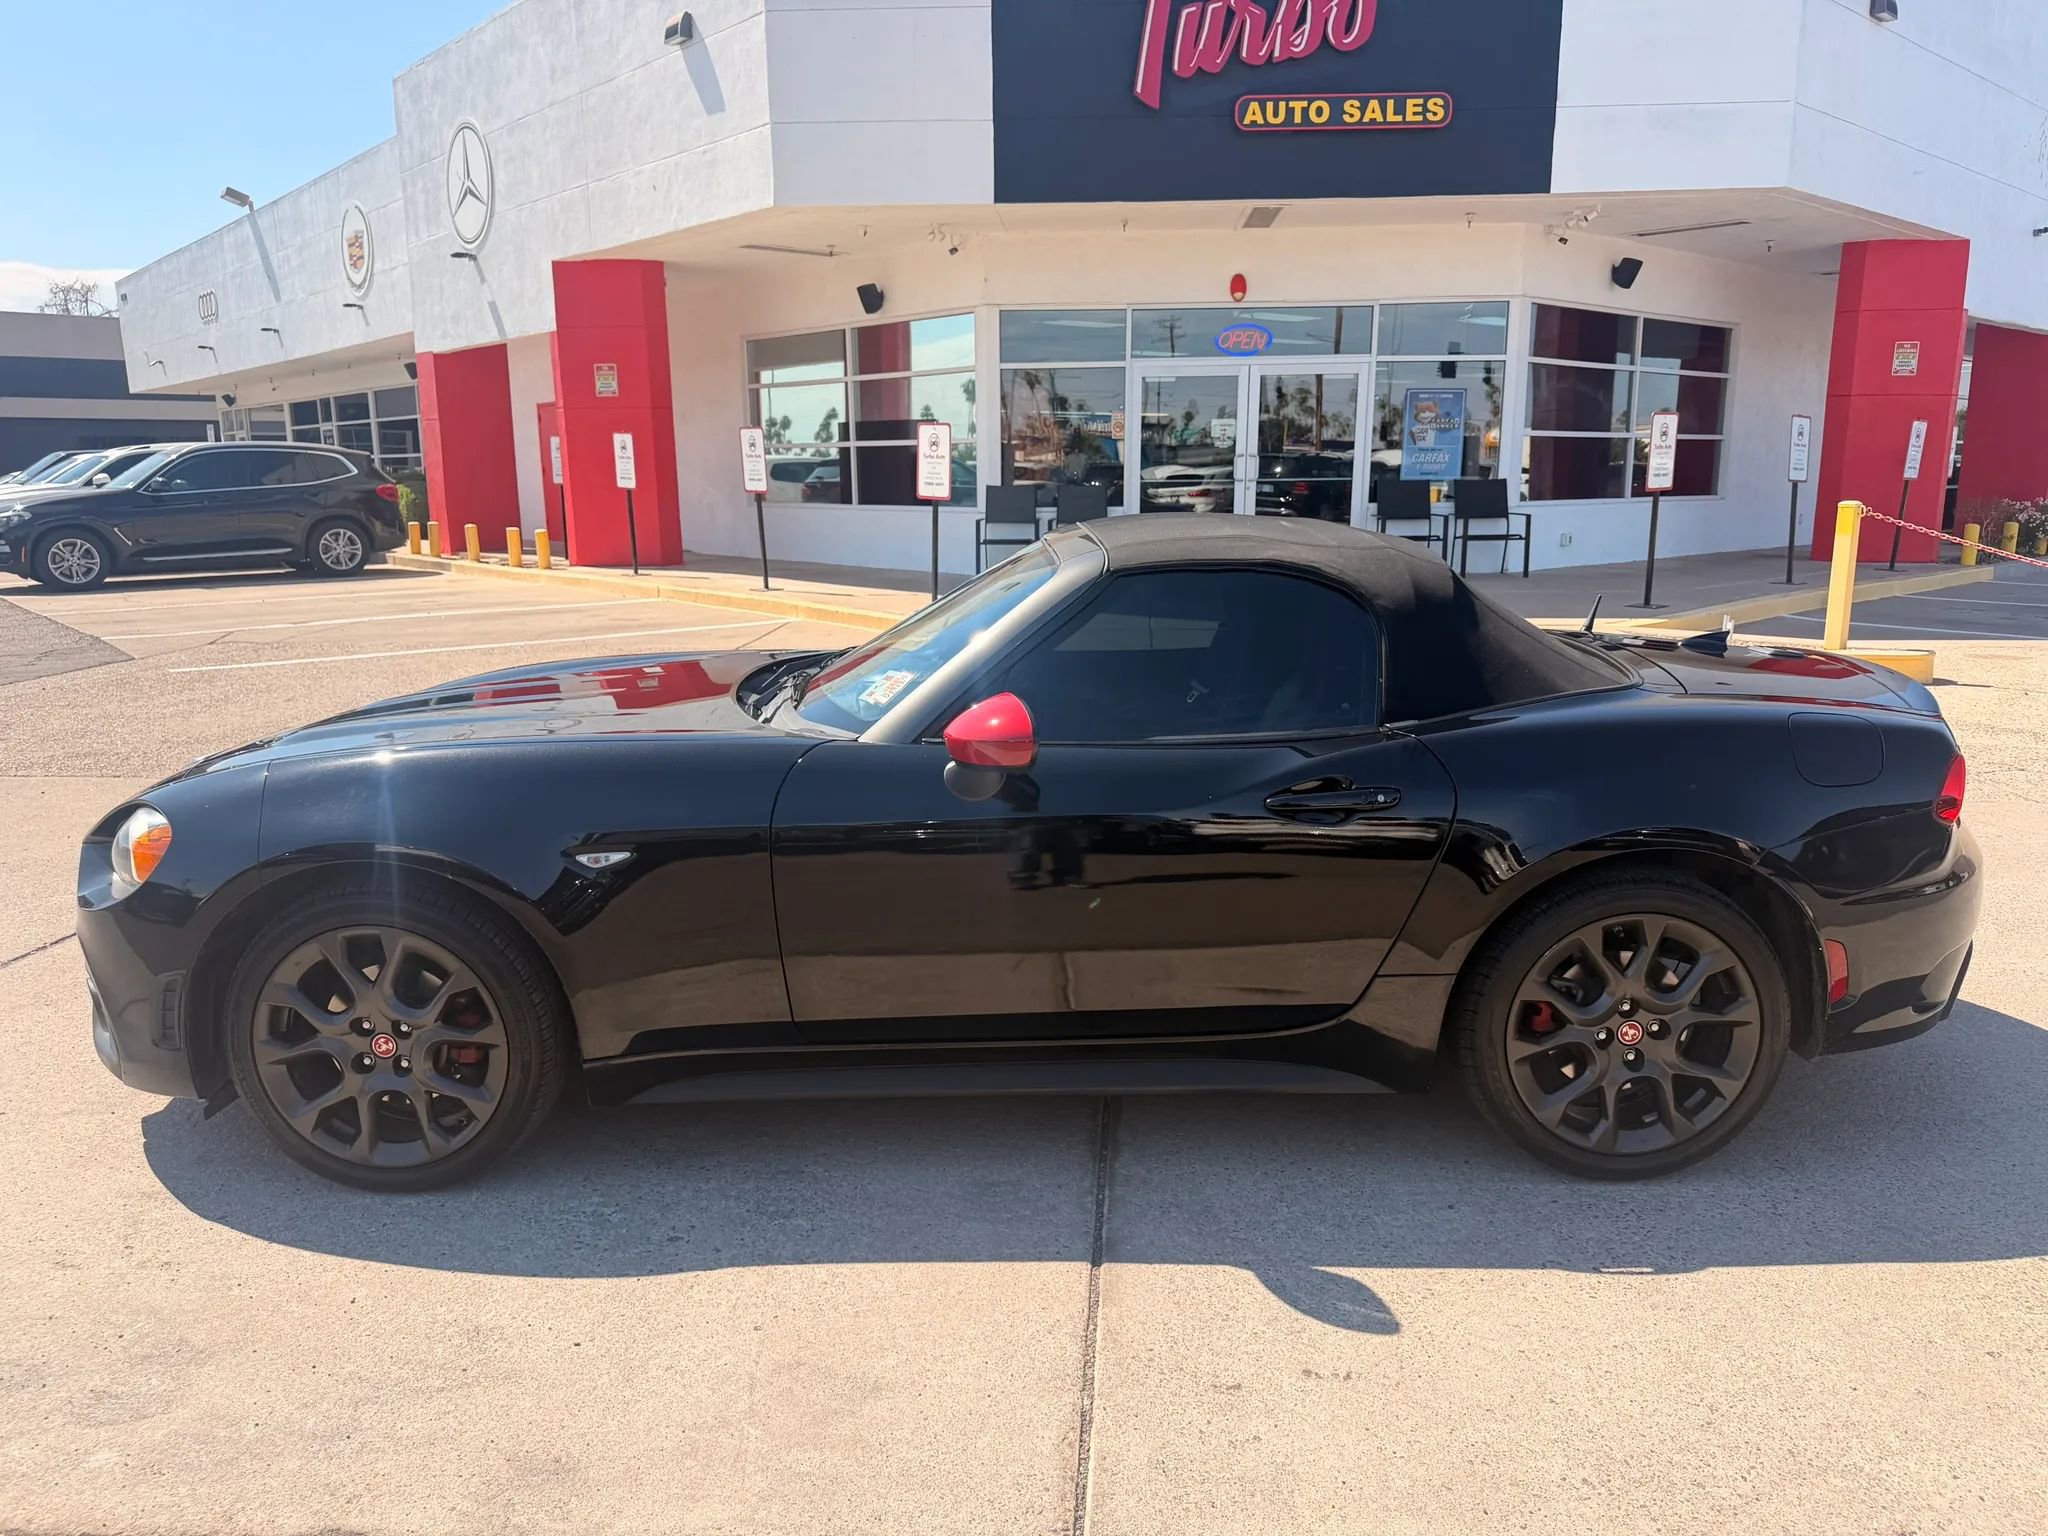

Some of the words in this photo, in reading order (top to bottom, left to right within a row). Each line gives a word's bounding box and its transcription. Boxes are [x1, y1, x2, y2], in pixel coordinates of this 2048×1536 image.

[1243, 100, 1330, 125] AUTO
[1342, 98, 1446, 123] SALES
[1218, 331, 1267, 351] OPEN
[1411, 453, 1451, 464] CARFAX
